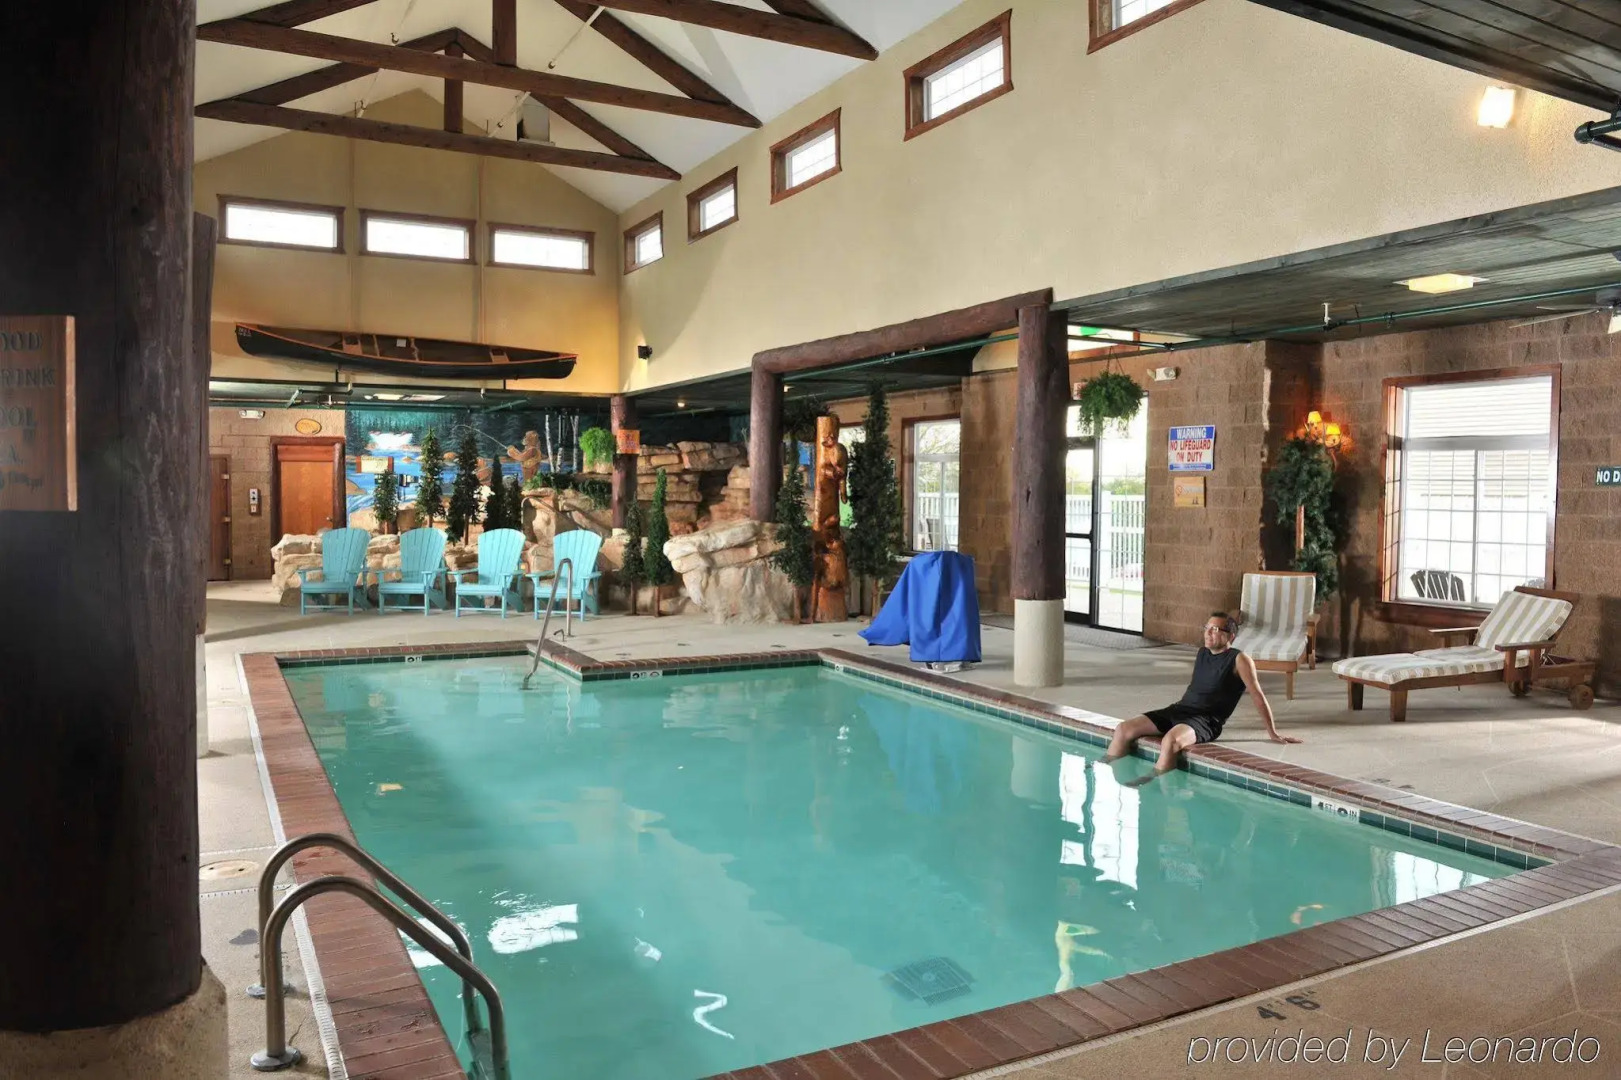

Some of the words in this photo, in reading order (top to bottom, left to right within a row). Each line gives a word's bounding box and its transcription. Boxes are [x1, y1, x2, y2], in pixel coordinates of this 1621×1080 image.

[1176, 428, 1207, 439] WARNING
[1170, 441, 1178, 451] NO
[1180, 440, 1211, 451] LIFEGUARD
[1176, 452, 1185, 462] ON
[1187, 452, 1203, 462] DUTY
[1596, 470, 1611, 483] NO
[1612, 470, 1621, 483] D
